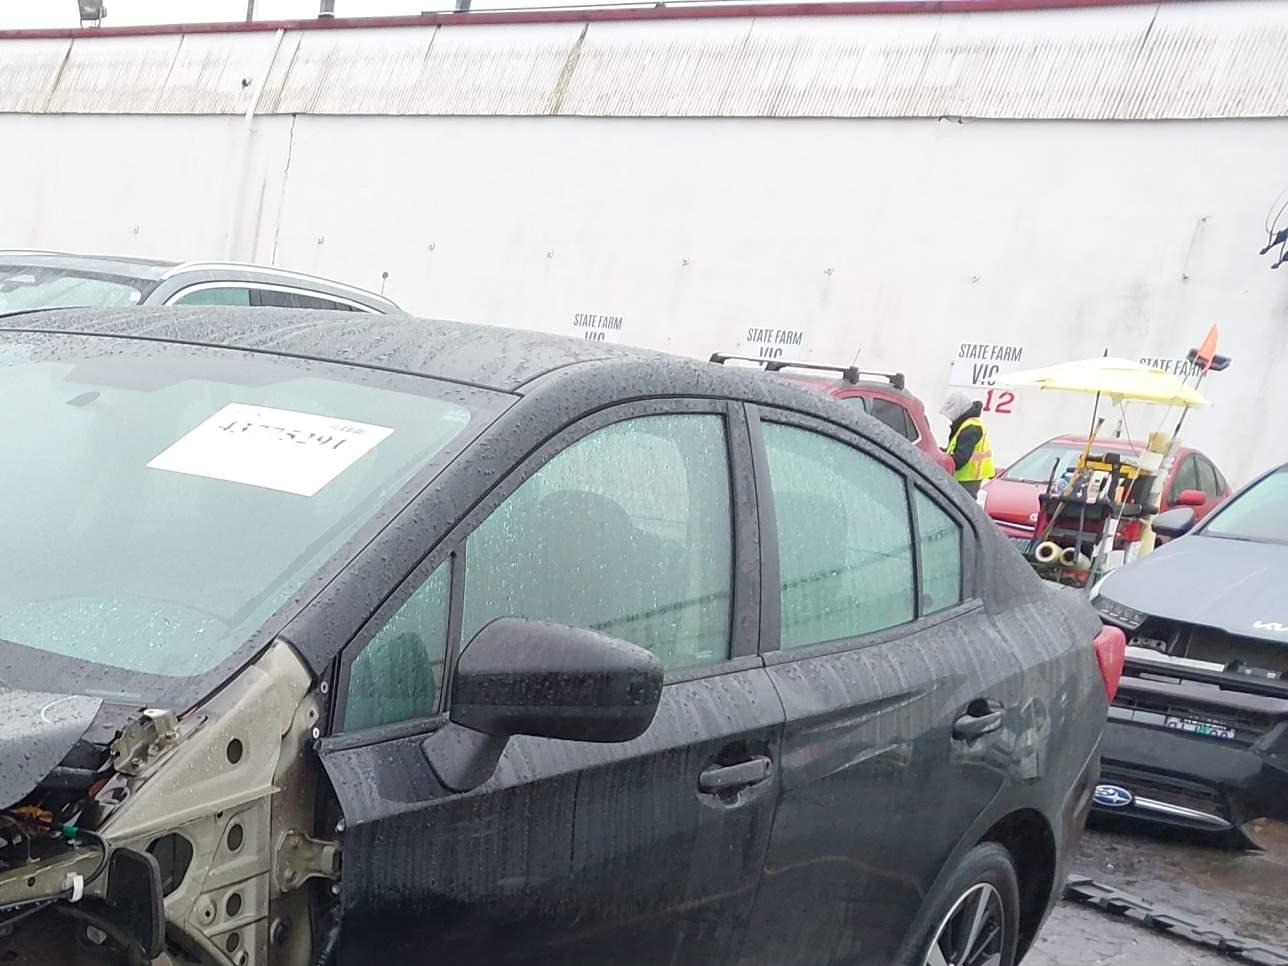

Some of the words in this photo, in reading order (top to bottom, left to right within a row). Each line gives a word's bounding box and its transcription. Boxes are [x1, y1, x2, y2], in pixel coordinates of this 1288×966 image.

[573, 313, 597, 328] STATE
[598, 315, 623, 330] FARM
[746, 328, 774, 343] STATE
[774, 329, 803, 345] FARM
[958, 343, 990, 360] STATE
[990, 345, 1023, 362] FARM
[982, 388, 1015, 414] 12
